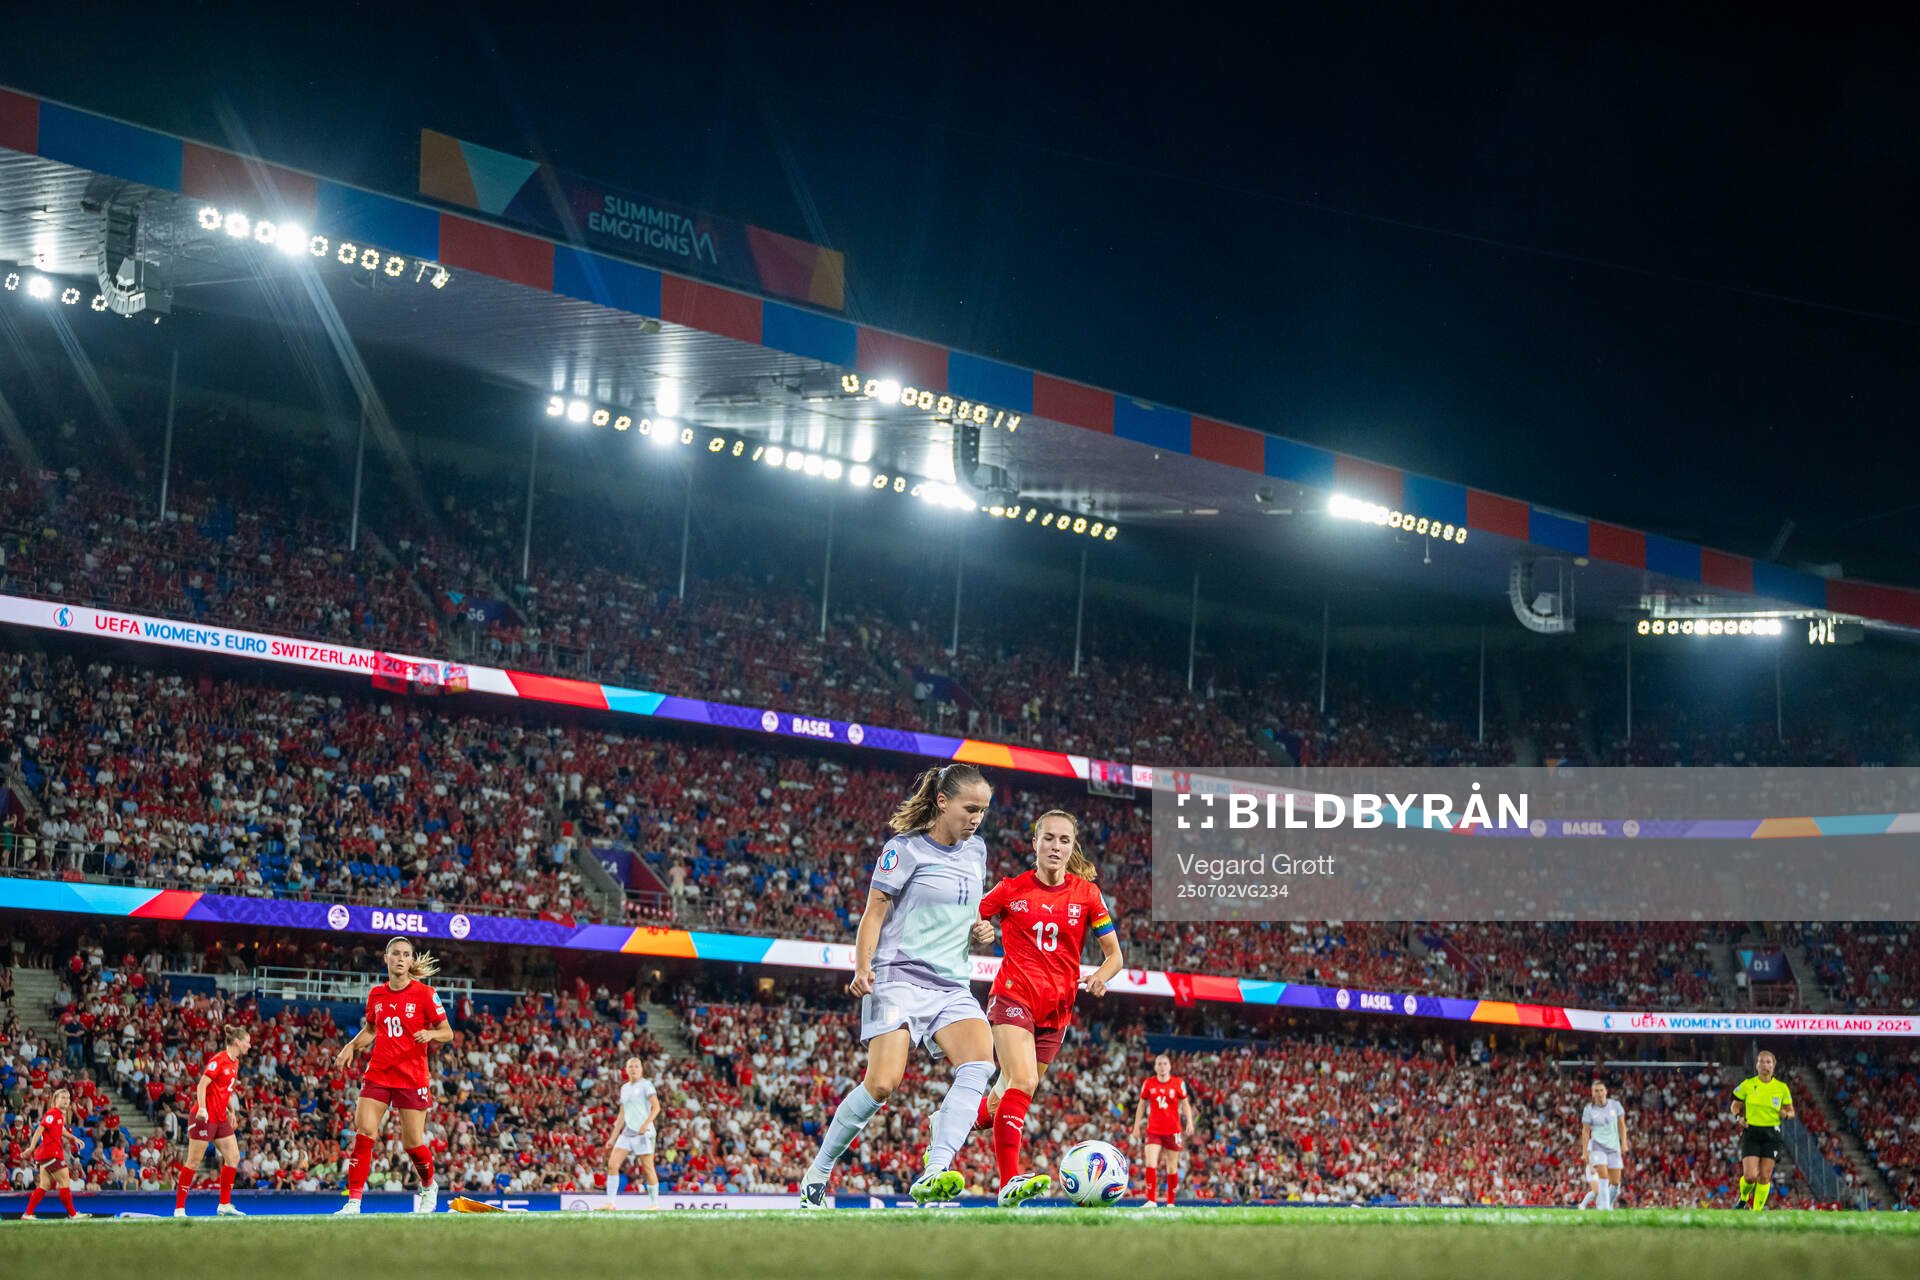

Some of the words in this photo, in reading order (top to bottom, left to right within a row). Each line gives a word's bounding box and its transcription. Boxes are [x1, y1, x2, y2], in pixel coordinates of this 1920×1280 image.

[604, 195, 681, 233] SUMMIT
[589, 212, 690, 256] EMOTIONS
[95, 615, 140, 635] UEFA
[144, 622, 220, 647] WOMEN'S
[225, 634, 267, 653] EURO
[271, 641, 379, 669] SWITZERLAND
[792, 717, 835, 738] BASEL
[1562, 821, 1607, 835] BASEL
[371, 911, 428, 933] BASEL
[1032, 921, 1059, 952] 13
[1360, 993, 1394, 1011] BASEL
[384, 1016, 403, 1038] 18
[1631, 1016, 1666, 1029] UEFA
[1669, 1017, 1732, 1029] WOMEN'S
[1735, 1018, 1772, 1030] EURO
[1775, 1018, 1872, 1031] SWITZERLAND
[1876, 1019, 1912, 1032] 2025
